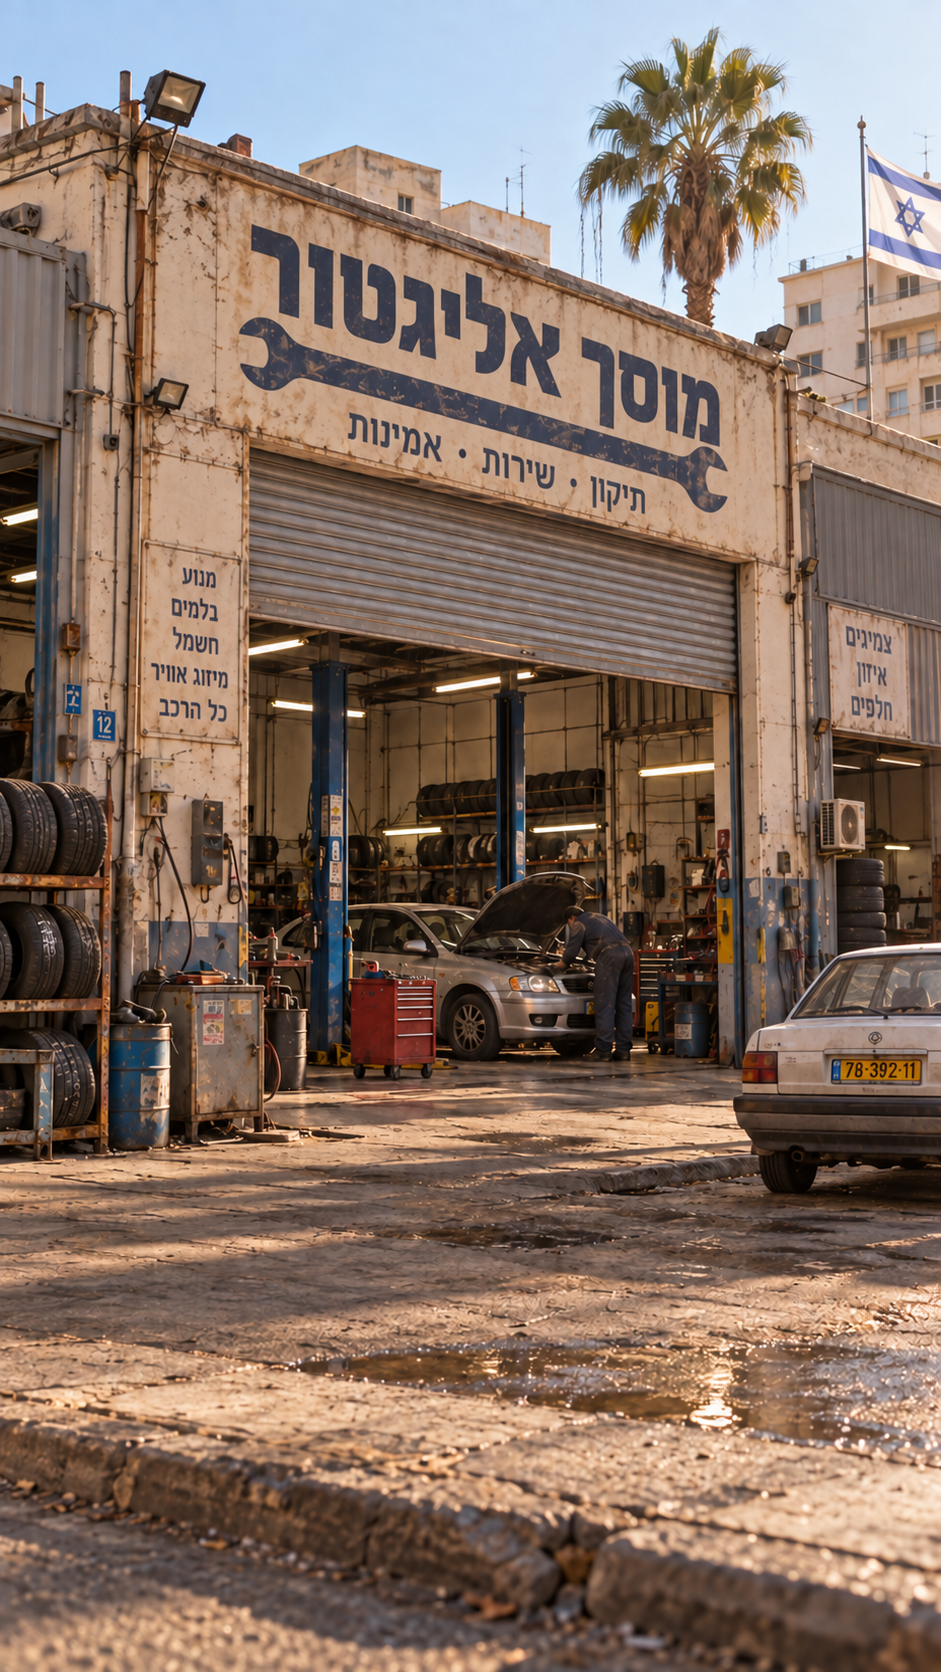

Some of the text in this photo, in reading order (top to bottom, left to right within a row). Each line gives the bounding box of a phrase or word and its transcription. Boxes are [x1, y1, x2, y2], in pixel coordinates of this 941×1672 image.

[251, 224, 721, 447] מוסך אליגטור
[347, 412, 646, 515] תיקון שירות אמינות
[183, 568, 216, 588] מנוע
[172, 598, 218, 621] בלמים
[173, 627, 218, 654] חשמל
[846, 626, 891, 654] צמיגים
[151, 663, 227, 688] מיזוג אוויר
[857, 662, 886, 687] איזון
[160, 699, 226, 722] כל הרכב
[851, 695, 892, 721] חלפים
[97, 715, 112, 734] 12
